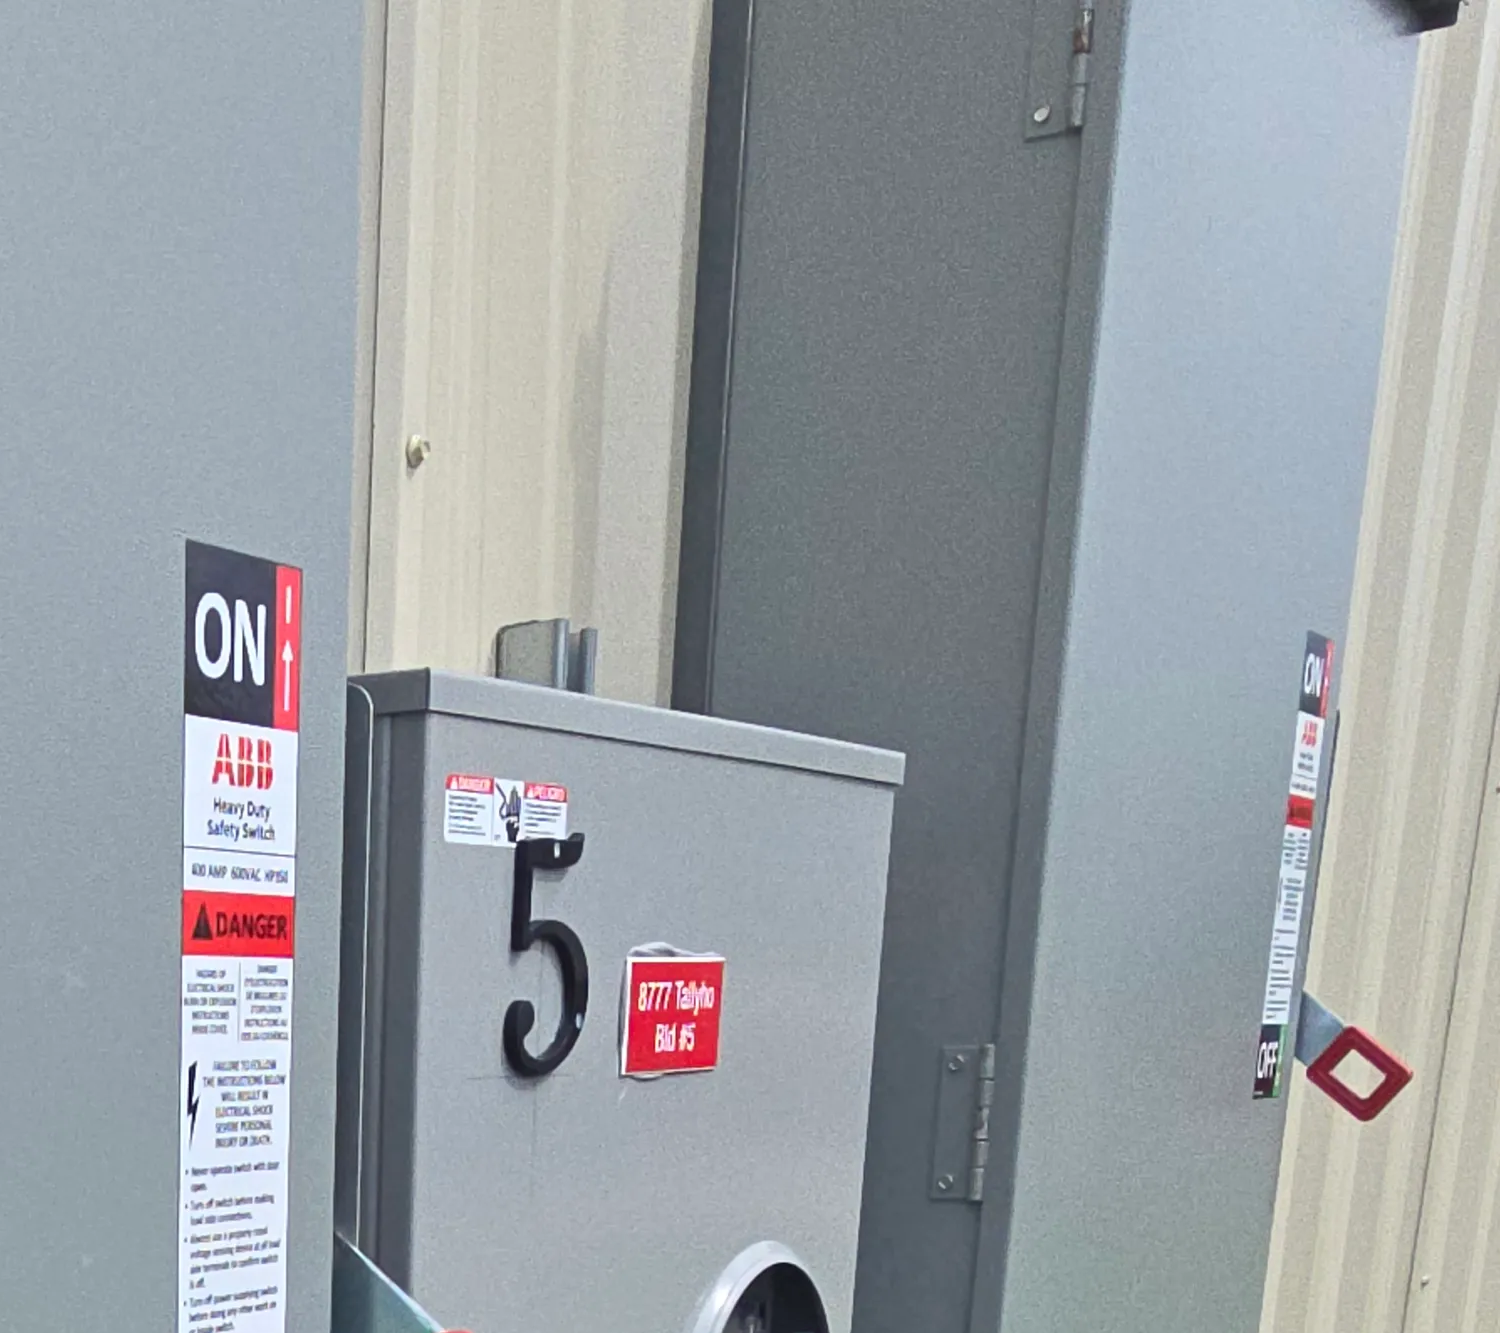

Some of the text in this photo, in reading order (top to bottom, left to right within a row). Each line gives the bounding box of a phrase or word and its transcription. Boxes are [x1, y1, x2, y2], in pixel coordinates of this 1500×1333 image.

[195, 592, 267, 686] ON
[1304, 653, 1325, 698] ON
[212, 734, 274, 790] ABB
[213, 797, 272, 823] Heavy Duty
[207, 819, 276, 842] Safety Switch
[216, 912, 288, 941] DANGER
[503, 833, 588, 1077] 5
[638, 980, 715, 1017] 8777 Tallyho
[655, 1022, 696, 1053] Bld #5
